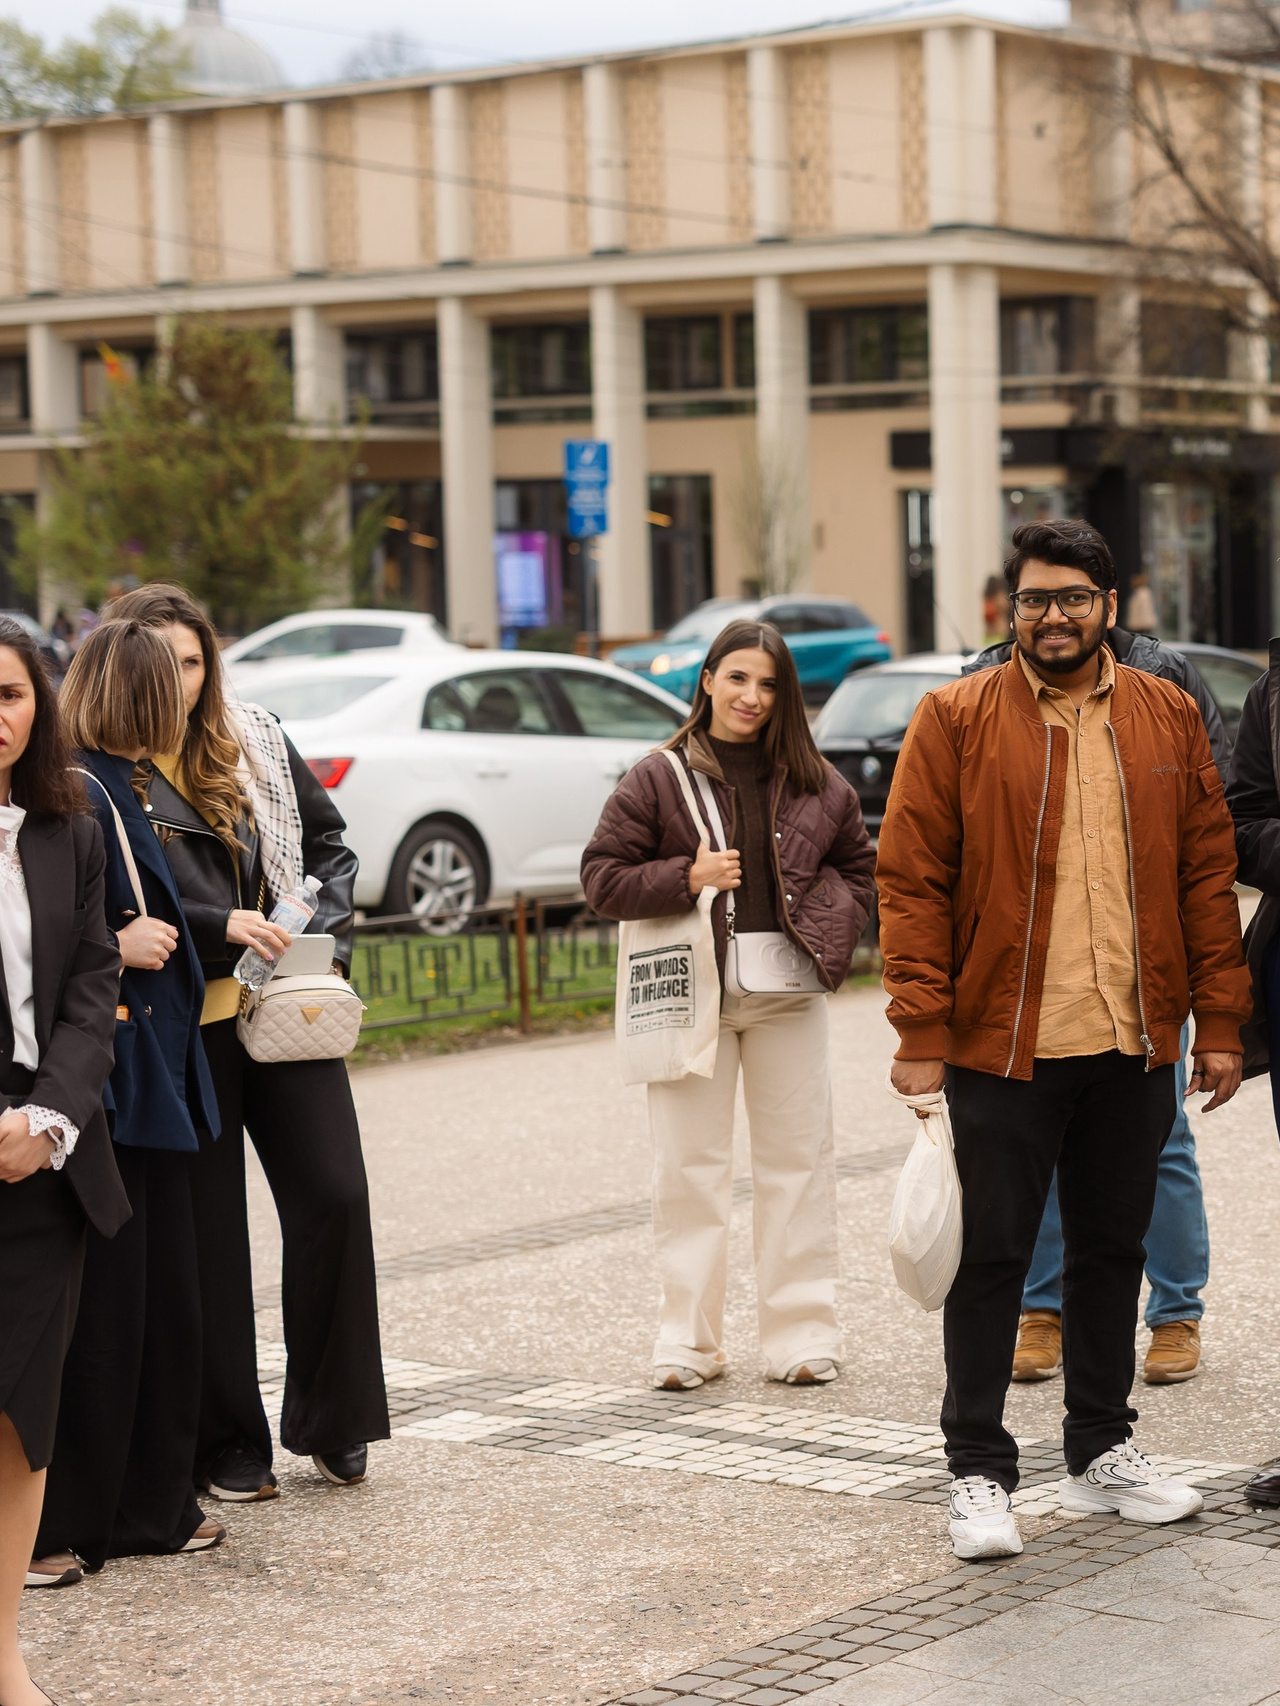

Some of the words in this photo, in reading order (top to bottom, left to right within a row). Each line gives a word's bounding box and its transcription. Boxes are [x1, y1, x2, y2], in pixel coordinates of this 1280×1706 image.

[654, 957, 688, 978] WORDS
[631, 986, 640, 1005] TO
[642, 978, 689, 1003] INFLUENCE
